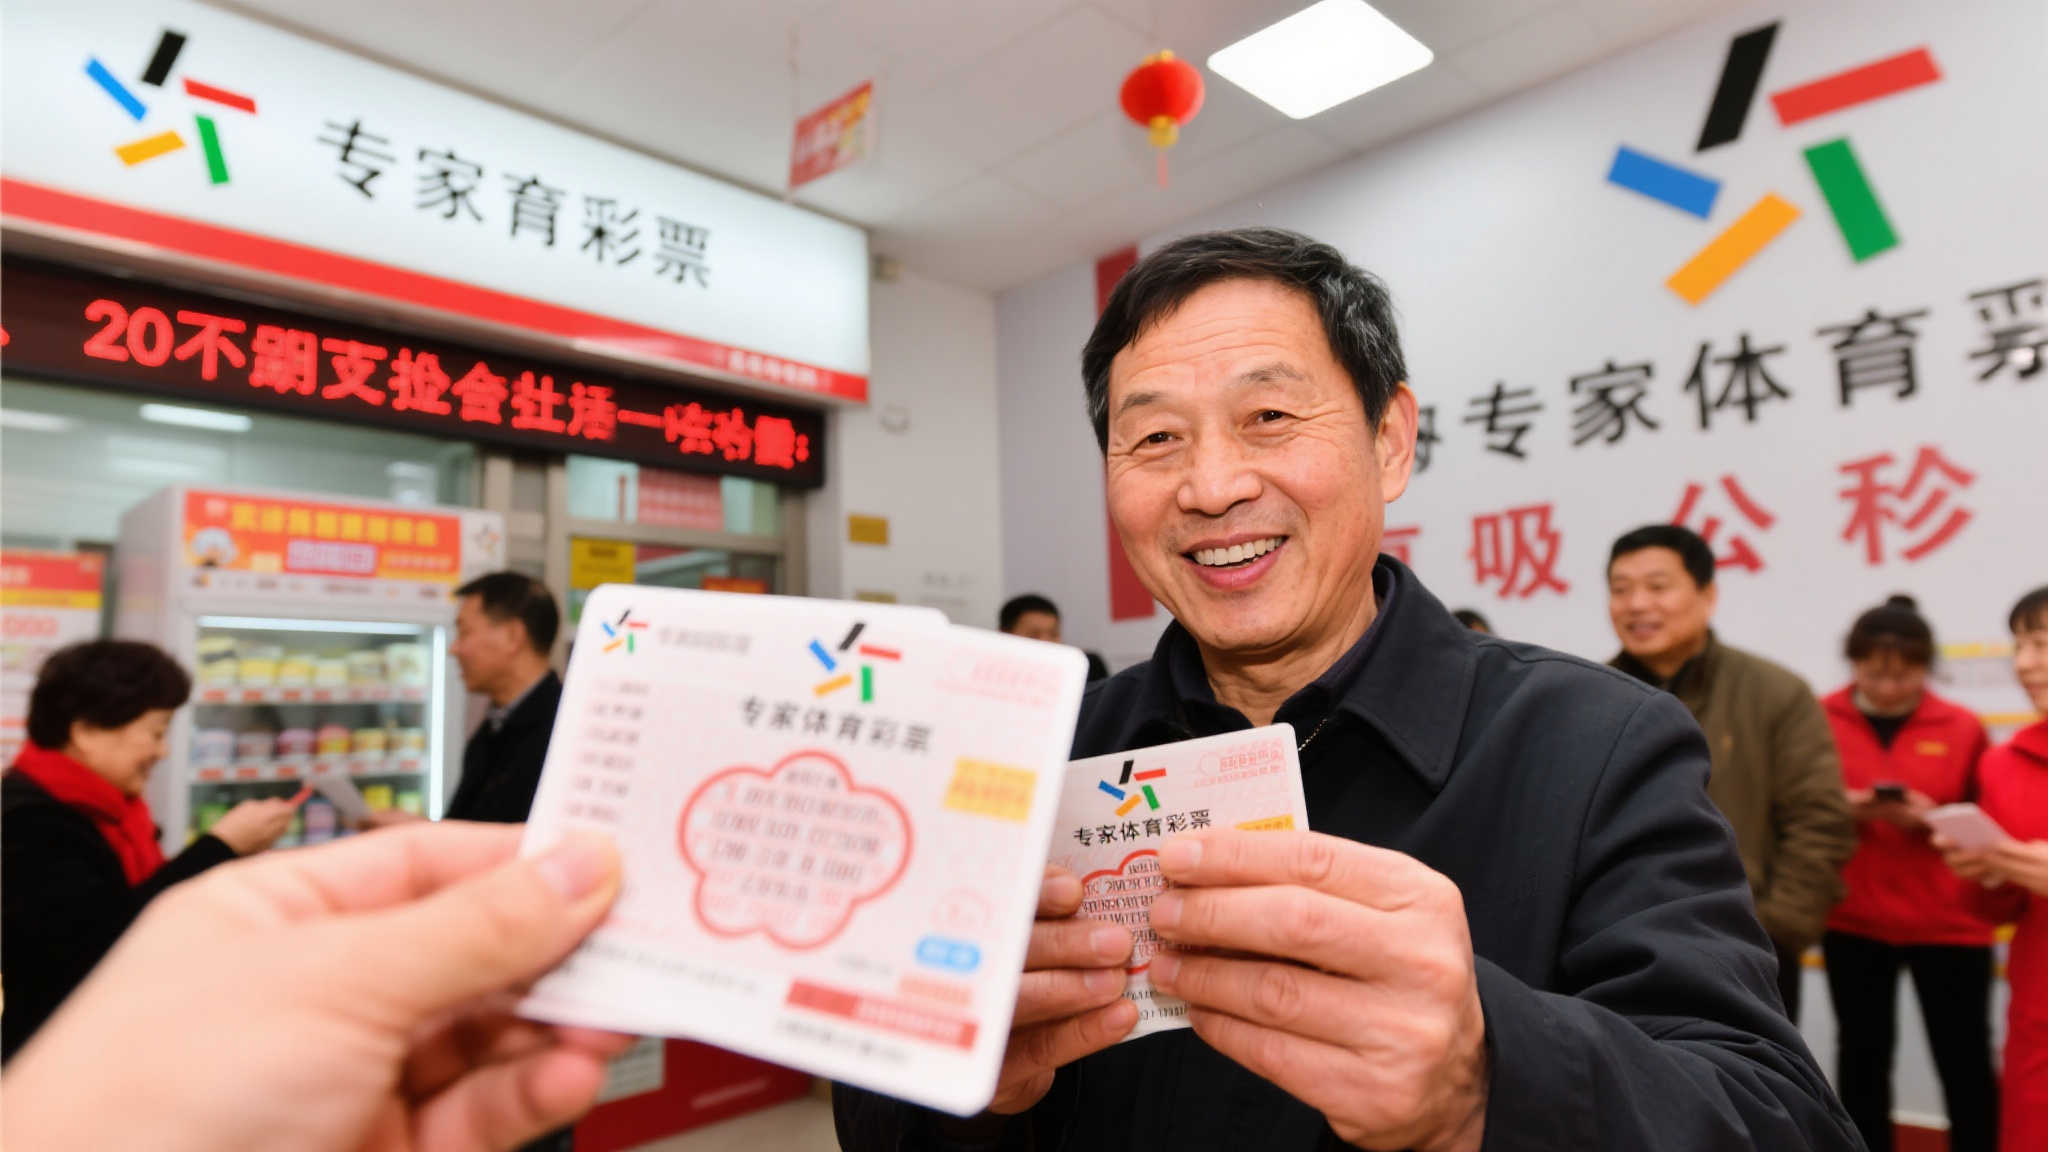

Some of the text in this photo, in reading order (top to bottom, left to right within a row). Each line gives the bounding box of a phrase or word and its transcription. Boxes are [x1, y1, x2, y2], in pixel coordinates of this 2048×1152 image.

[317, 119, 713, 290] 专家育彩票
[1073, 808, 1212, 846] 专家体育彩票
